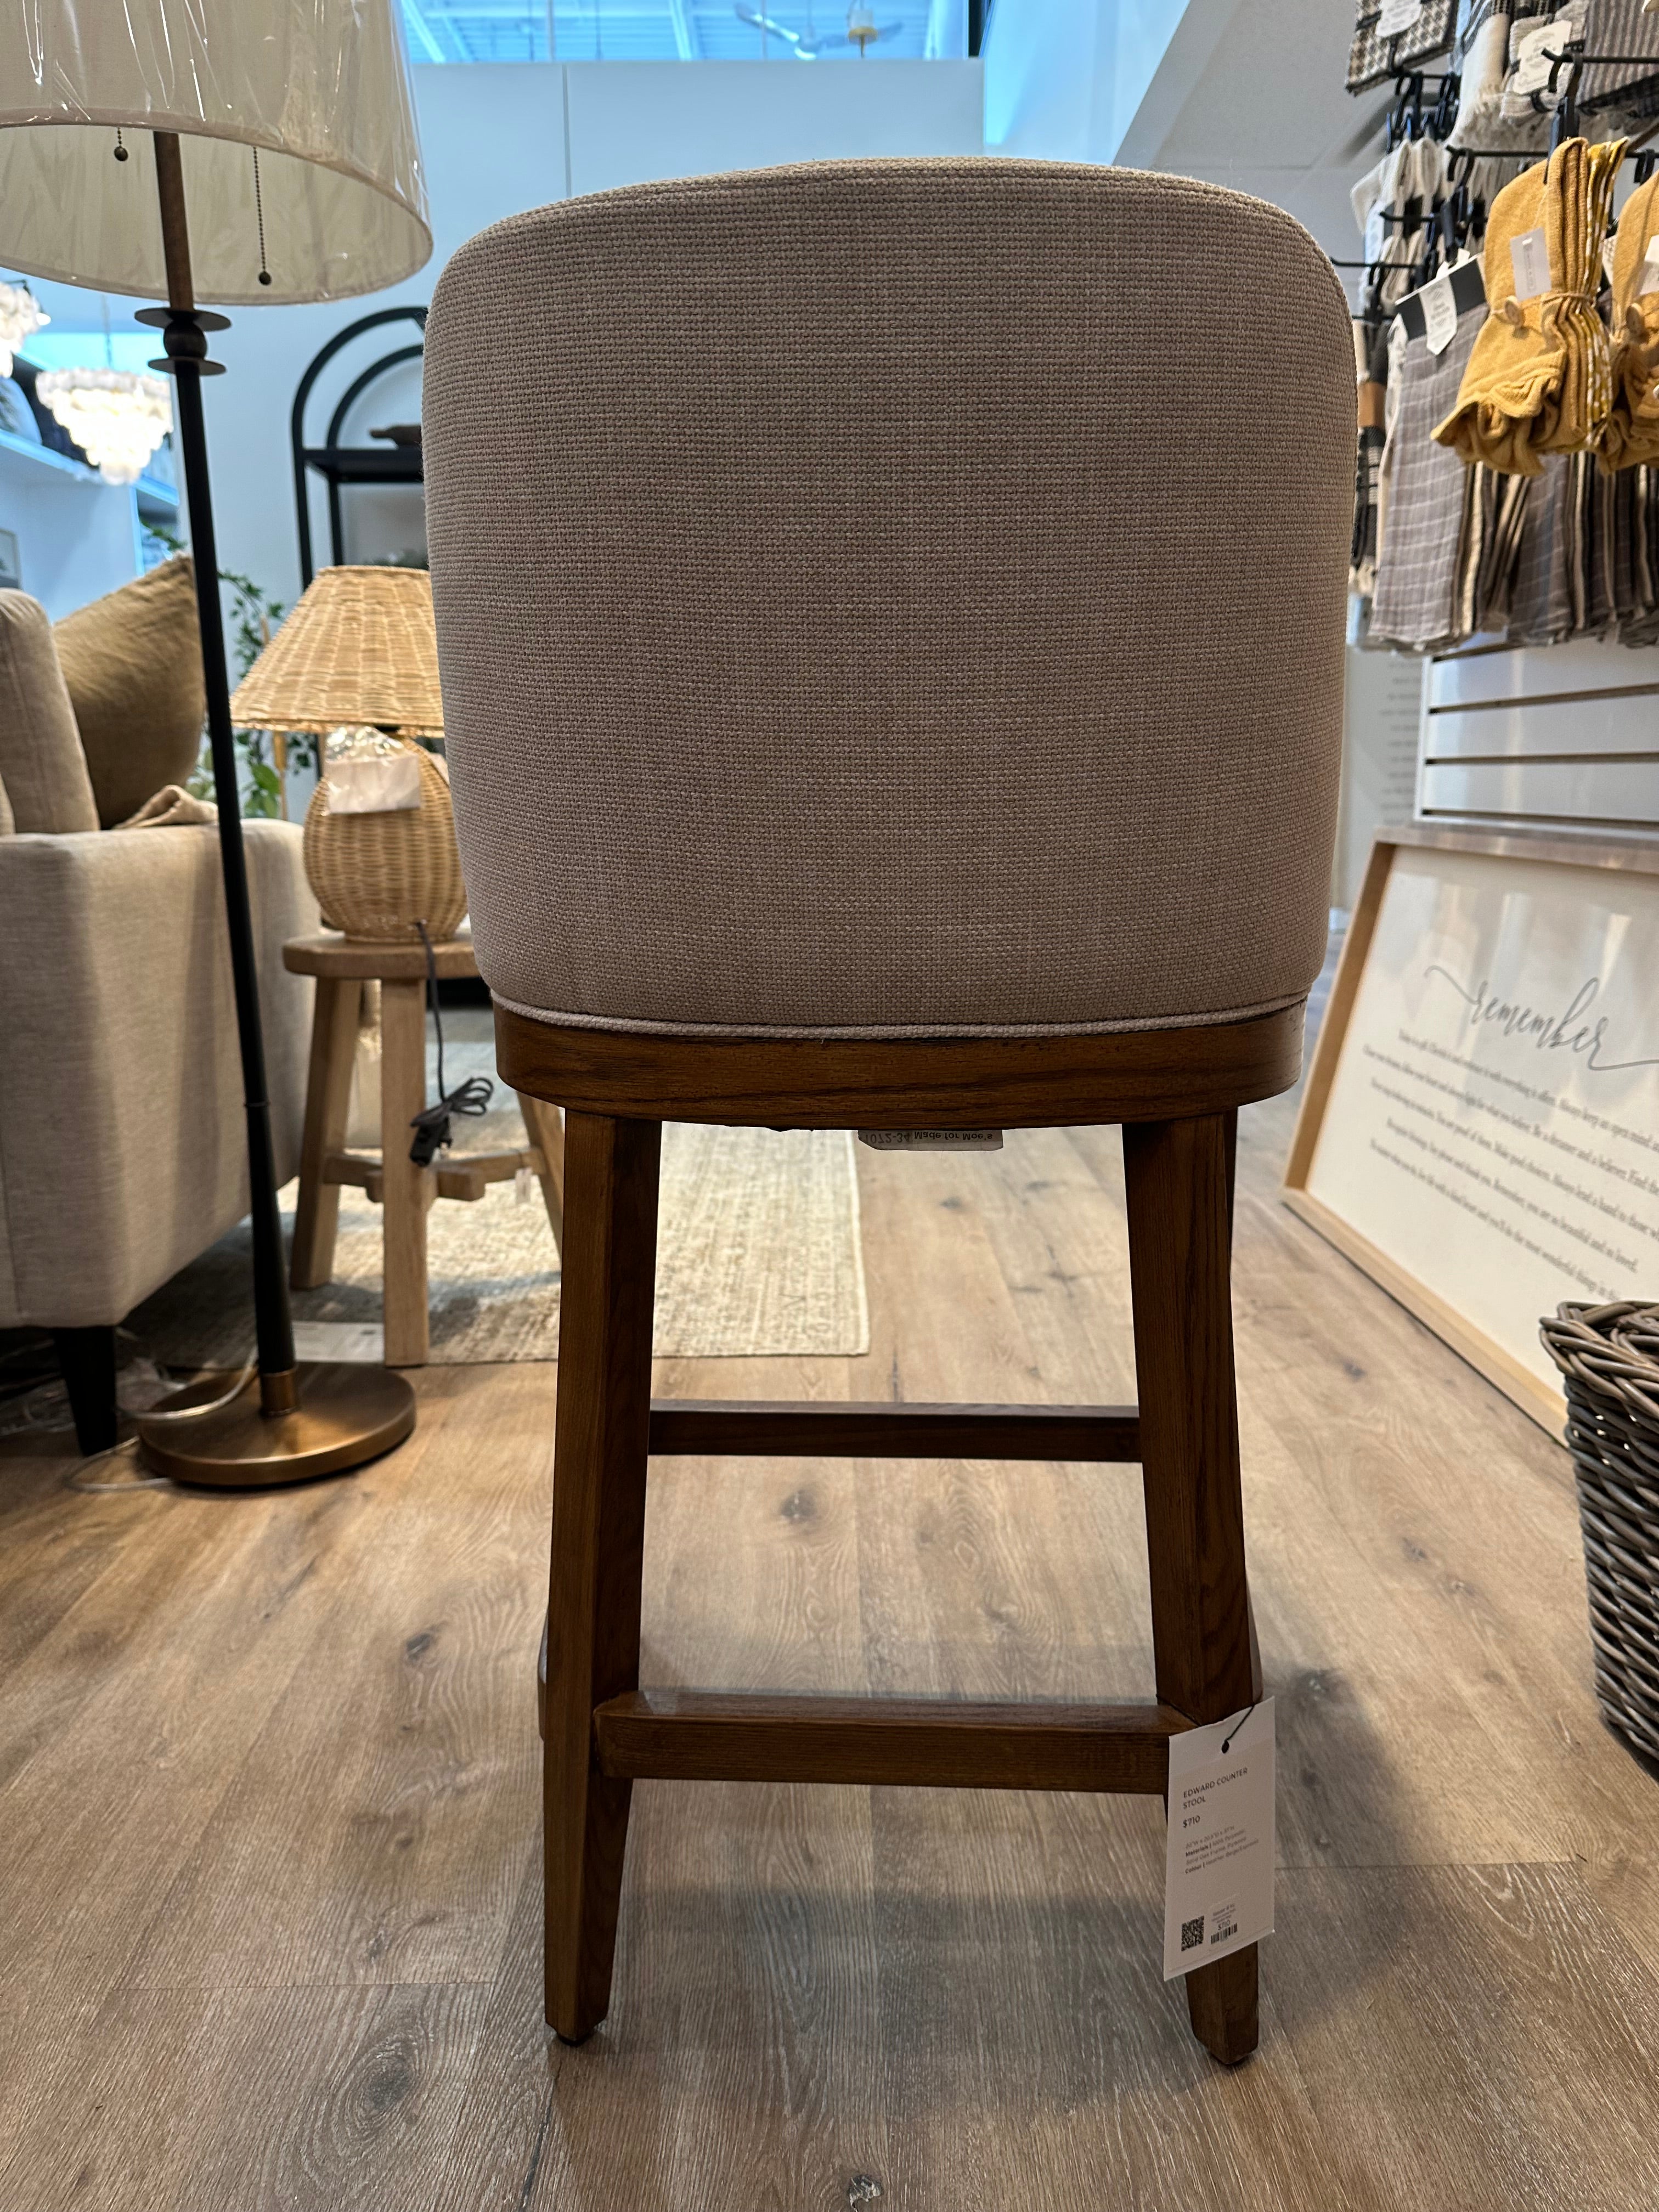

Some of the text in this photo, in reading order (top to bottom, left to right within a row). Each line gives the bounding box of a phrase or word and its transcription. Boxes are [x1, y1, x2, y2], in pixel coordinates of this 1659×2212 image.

[1425, 966, 1659, 1071] remember
[1183, 1767, 1248, 1798] EDWARD COUNTER
[1183, 1795, 1206, 1809] STOOL
[1183, 1815, 1201, 1829] $710
